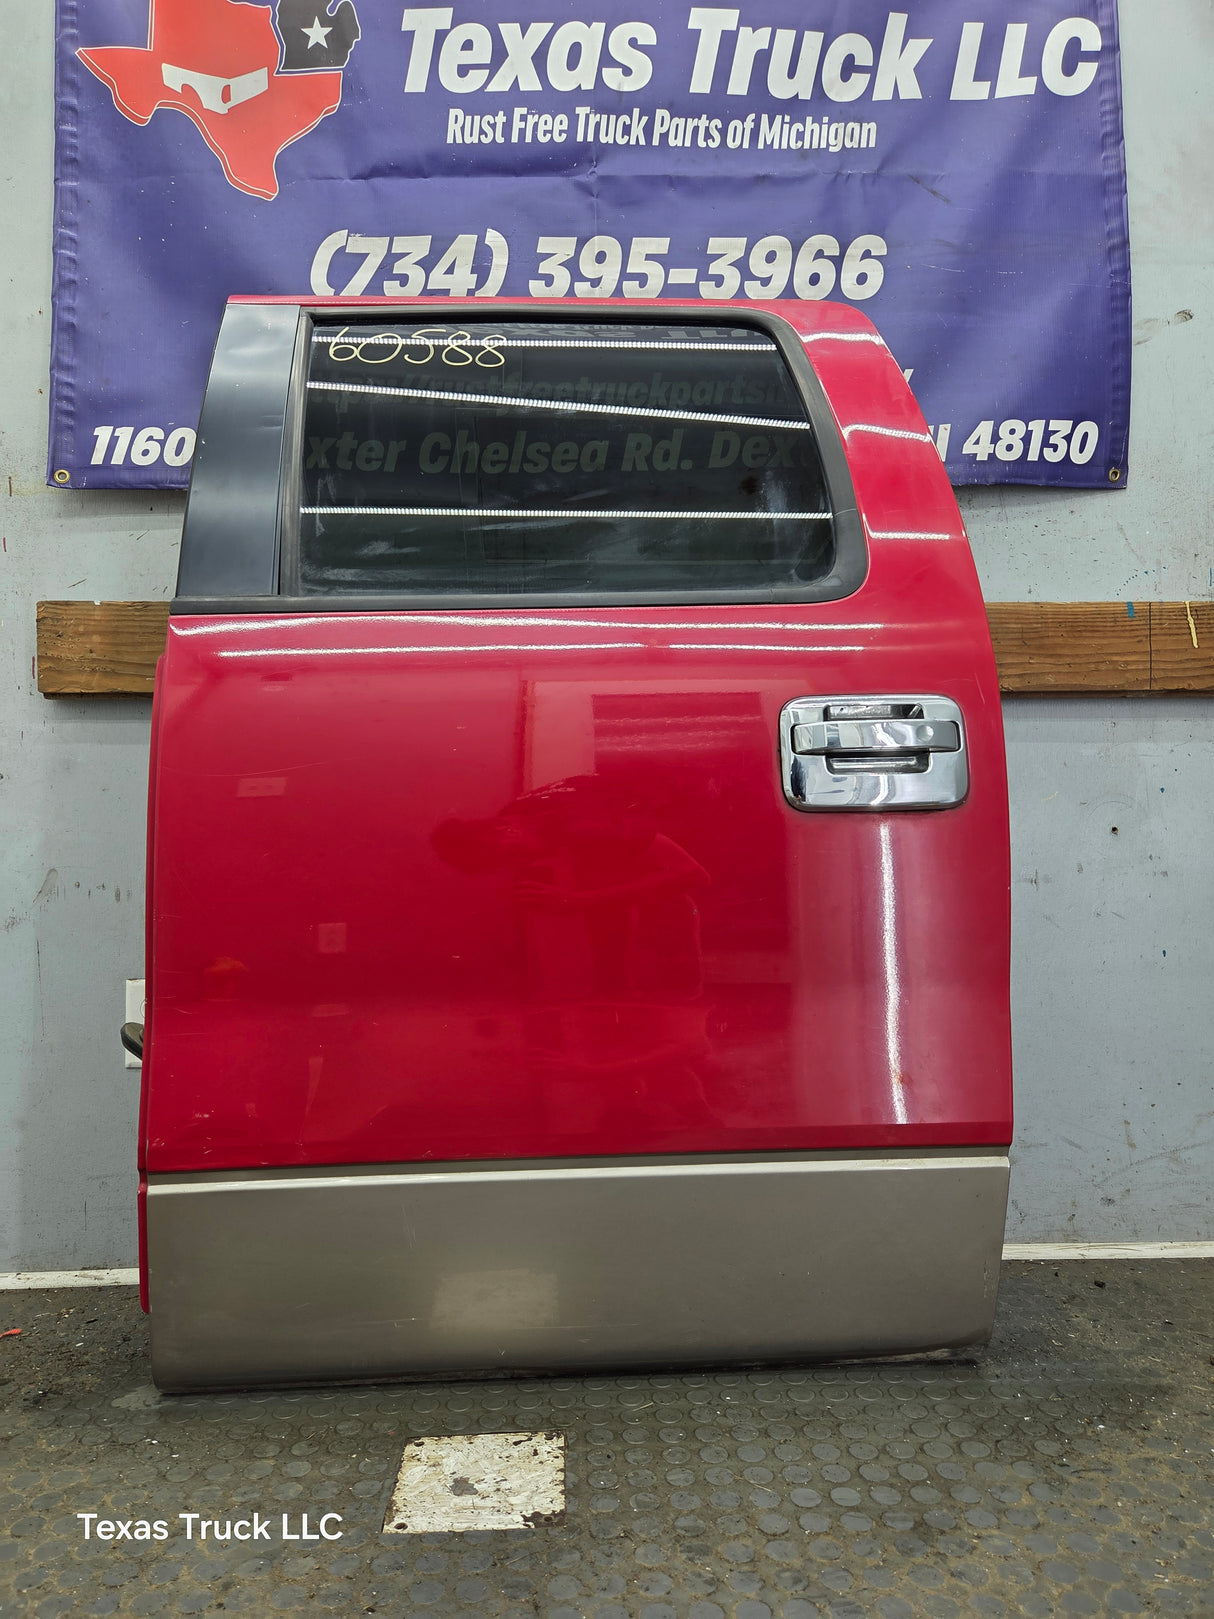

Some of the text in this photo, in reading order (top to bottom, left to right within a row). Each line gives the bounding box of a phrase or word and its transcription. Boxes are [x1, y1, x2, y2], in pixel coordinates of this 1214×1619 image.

[401, 7, 1103, 103] Texas Truck LLC
[446, 106, 877, 153] Rust Free Truck Parts of Michigan
[309, 227, 888, 299] (734) 395-3966
[328, 327, 508, 368] 60588
[306, 430, 407, 472] xter
[418, 428, 610, 474] Chelsea
[620, 428, 694, 473] Rd.
[961, 419, 1099, 465] 48130
